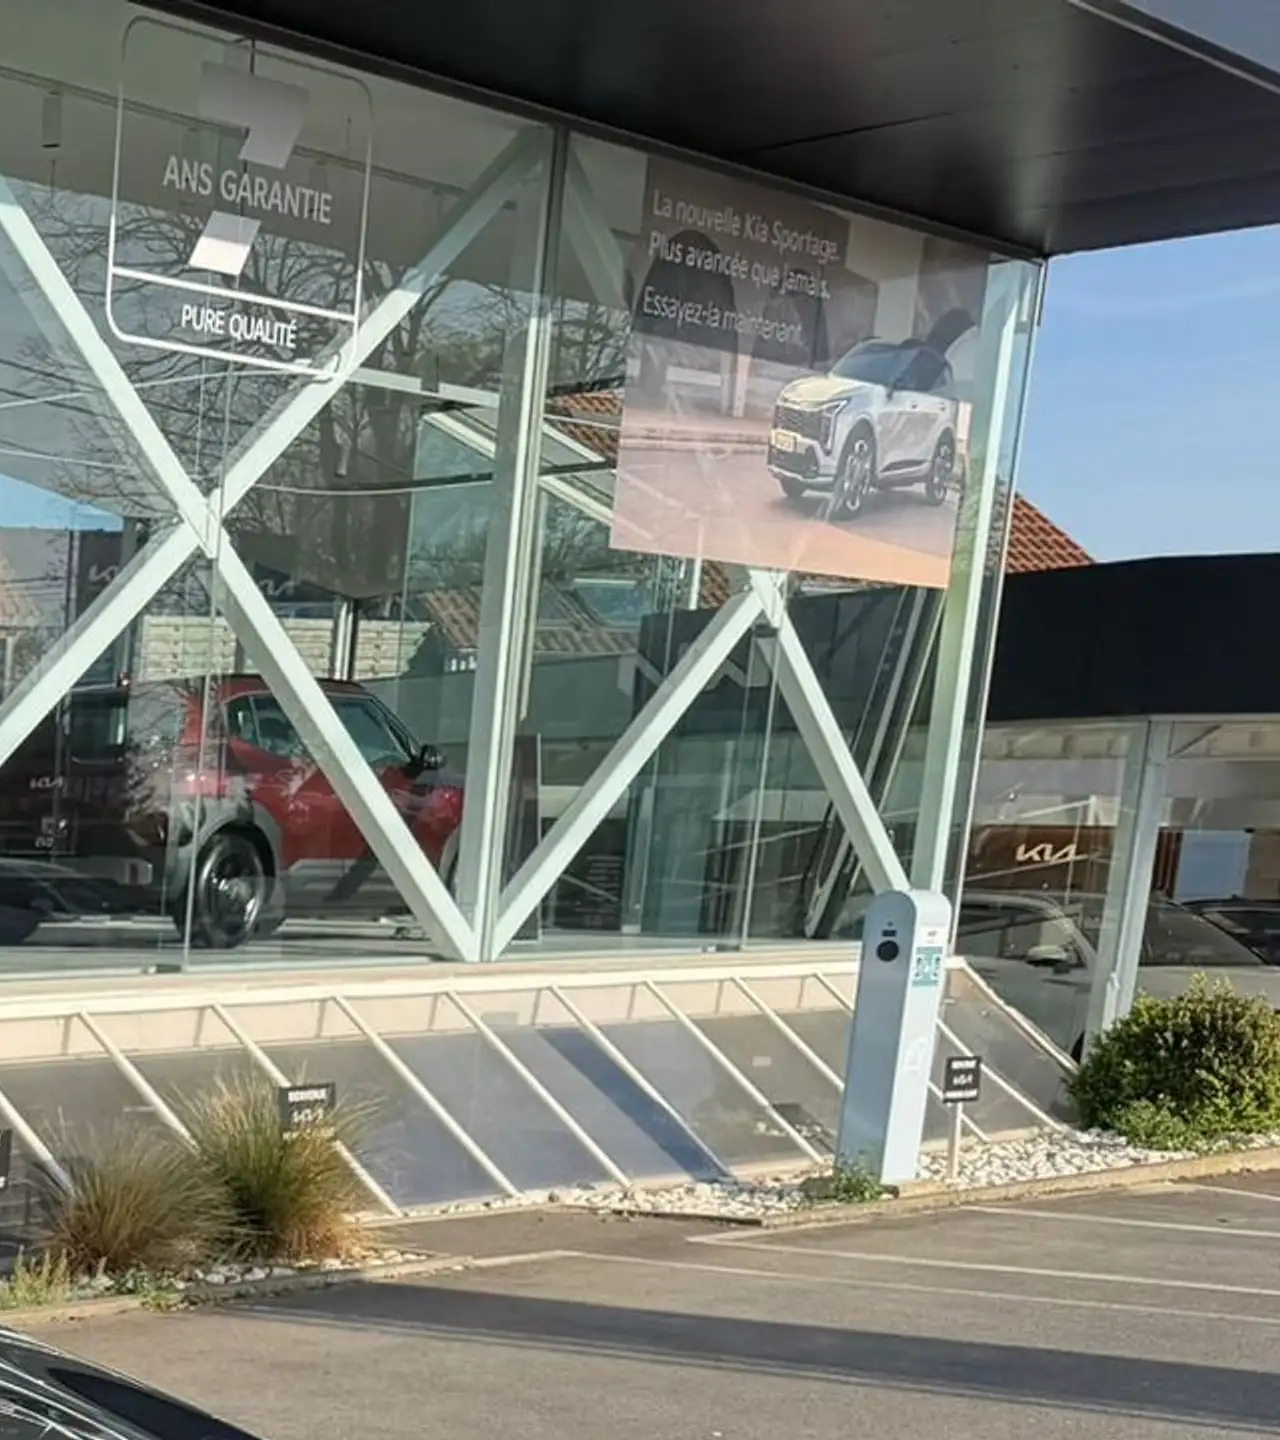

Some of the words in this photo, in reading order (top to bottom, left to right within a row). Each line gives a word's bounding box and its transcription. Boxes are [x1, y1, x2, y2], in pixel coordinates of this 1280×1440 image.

[162, 154, 212, 196] ANS
[220, 169, 333, 225] GARANTIE
[652, 188, 673, 217] La
[675, 200, 740, 236] nouvelle
[743, 214, 769, 243] Kia
[648, 230, 684, 262] Plus
[686, 244, 749, 280] avancée
[751, 261, 780, 290] que
[181, 304, 225, 334] PURE
[228, 313, 297, 348] QUALITÉ
[642, 285, 720, 328] Essayez-la
[1015, 843, 1077, 863] KIA
